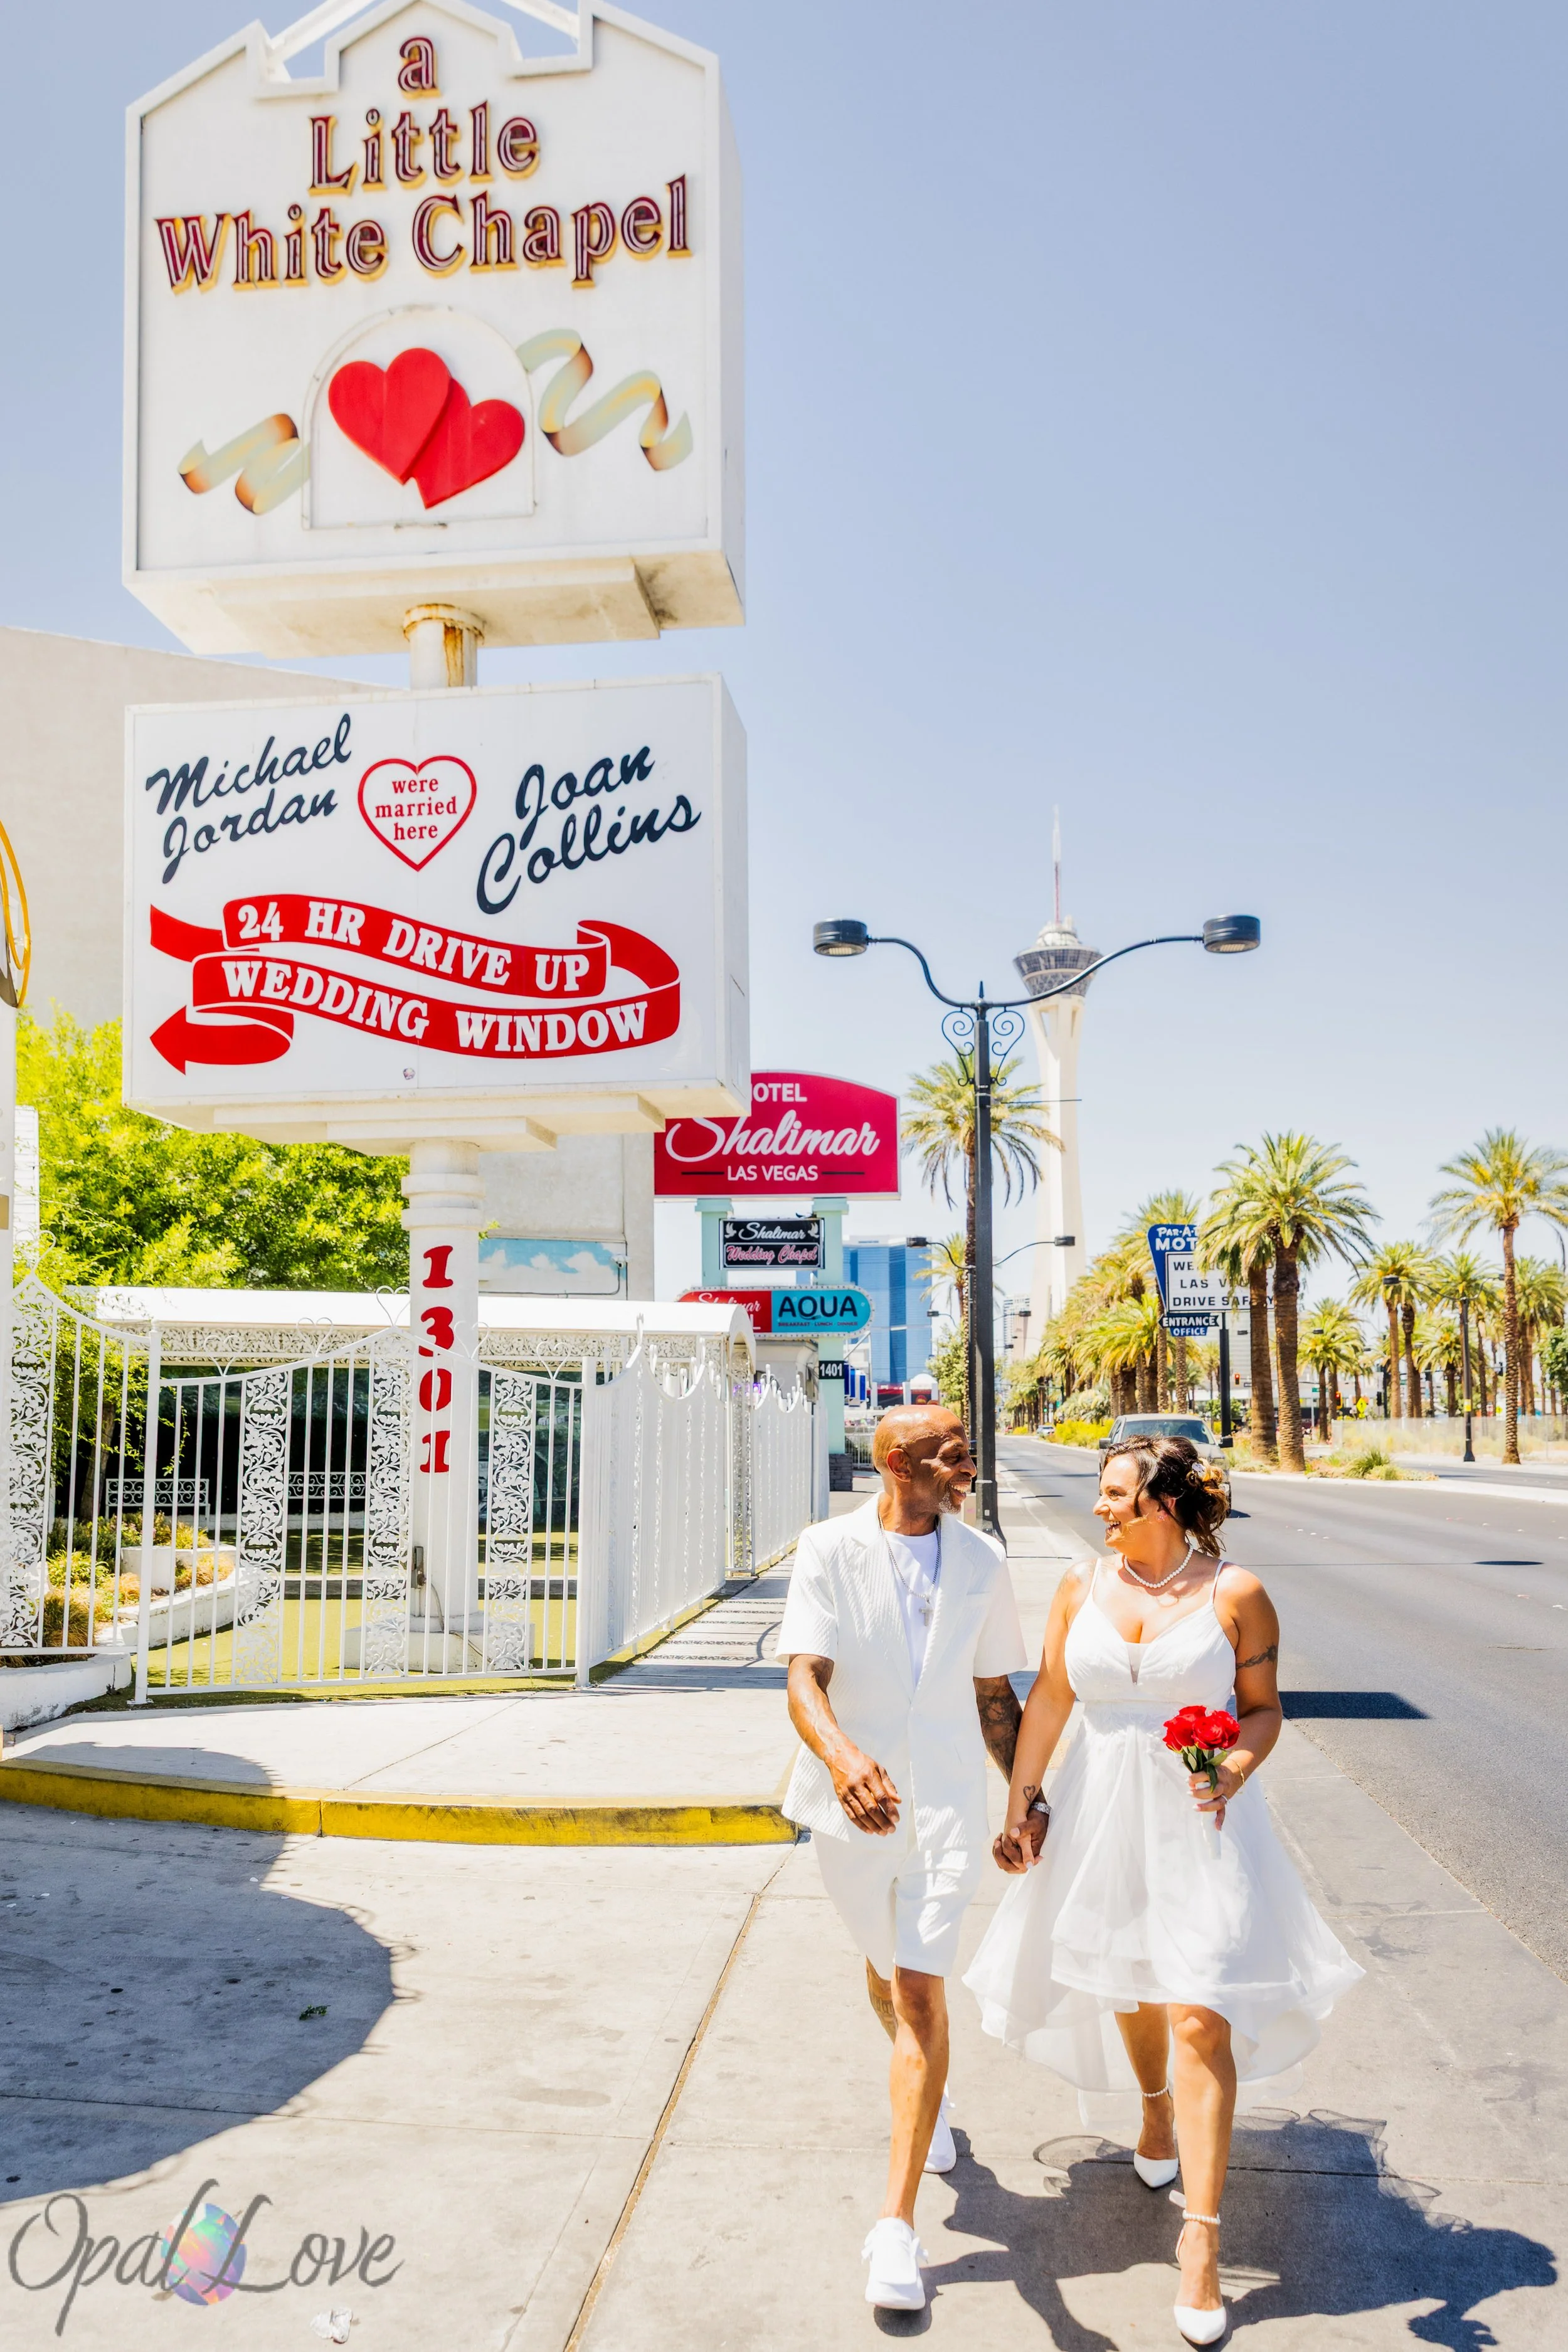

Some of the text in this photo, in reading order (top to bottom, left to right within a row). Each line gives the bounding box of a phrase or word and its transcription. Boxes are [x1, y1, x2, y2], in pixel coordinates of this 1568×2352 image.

[397, 36, 440, 97] a
[309, 100, 540, 196] Little
[154, 174, 692, 294] White Chapel
[146, 713, 352, 815] Michael
[391, 775, 438, 794] were
[374, 796, 457, 818] married
[516, 745, 655, 849] Joan
[161, 788, 337, 884] Jordan
[394, 820, 438, 840] here
[475, 795, 701, 914] Collins
[237, 901, 591, 992] 24 HR DRIVE UP
[221, 960, 648, 1052] WEDDING WINDOW
[751, 1083, 807, 1103] OTEL
[665, 1110, 881, 1162] Shalimar
[728, 1165, 818, 1181] LAS VEGAS
[739, 1222, 806, 1241] Shalimar
[726, 1244, 817, 1265] Wedding Chapel
[1155, 1237, 1199, 1251] MOT
[1180, 1279, 1209, 1288] LAS
[778, 1295, 857, 1320] AQUA
[1173, 1296, 1274, 1306] DRIVE SAFY
[1162, 1316, 1216, 1327] ENTRANCE
[1173, 1328, 1205, 1336] OFFICE
[820, 1364, 843, 1377] 1401
